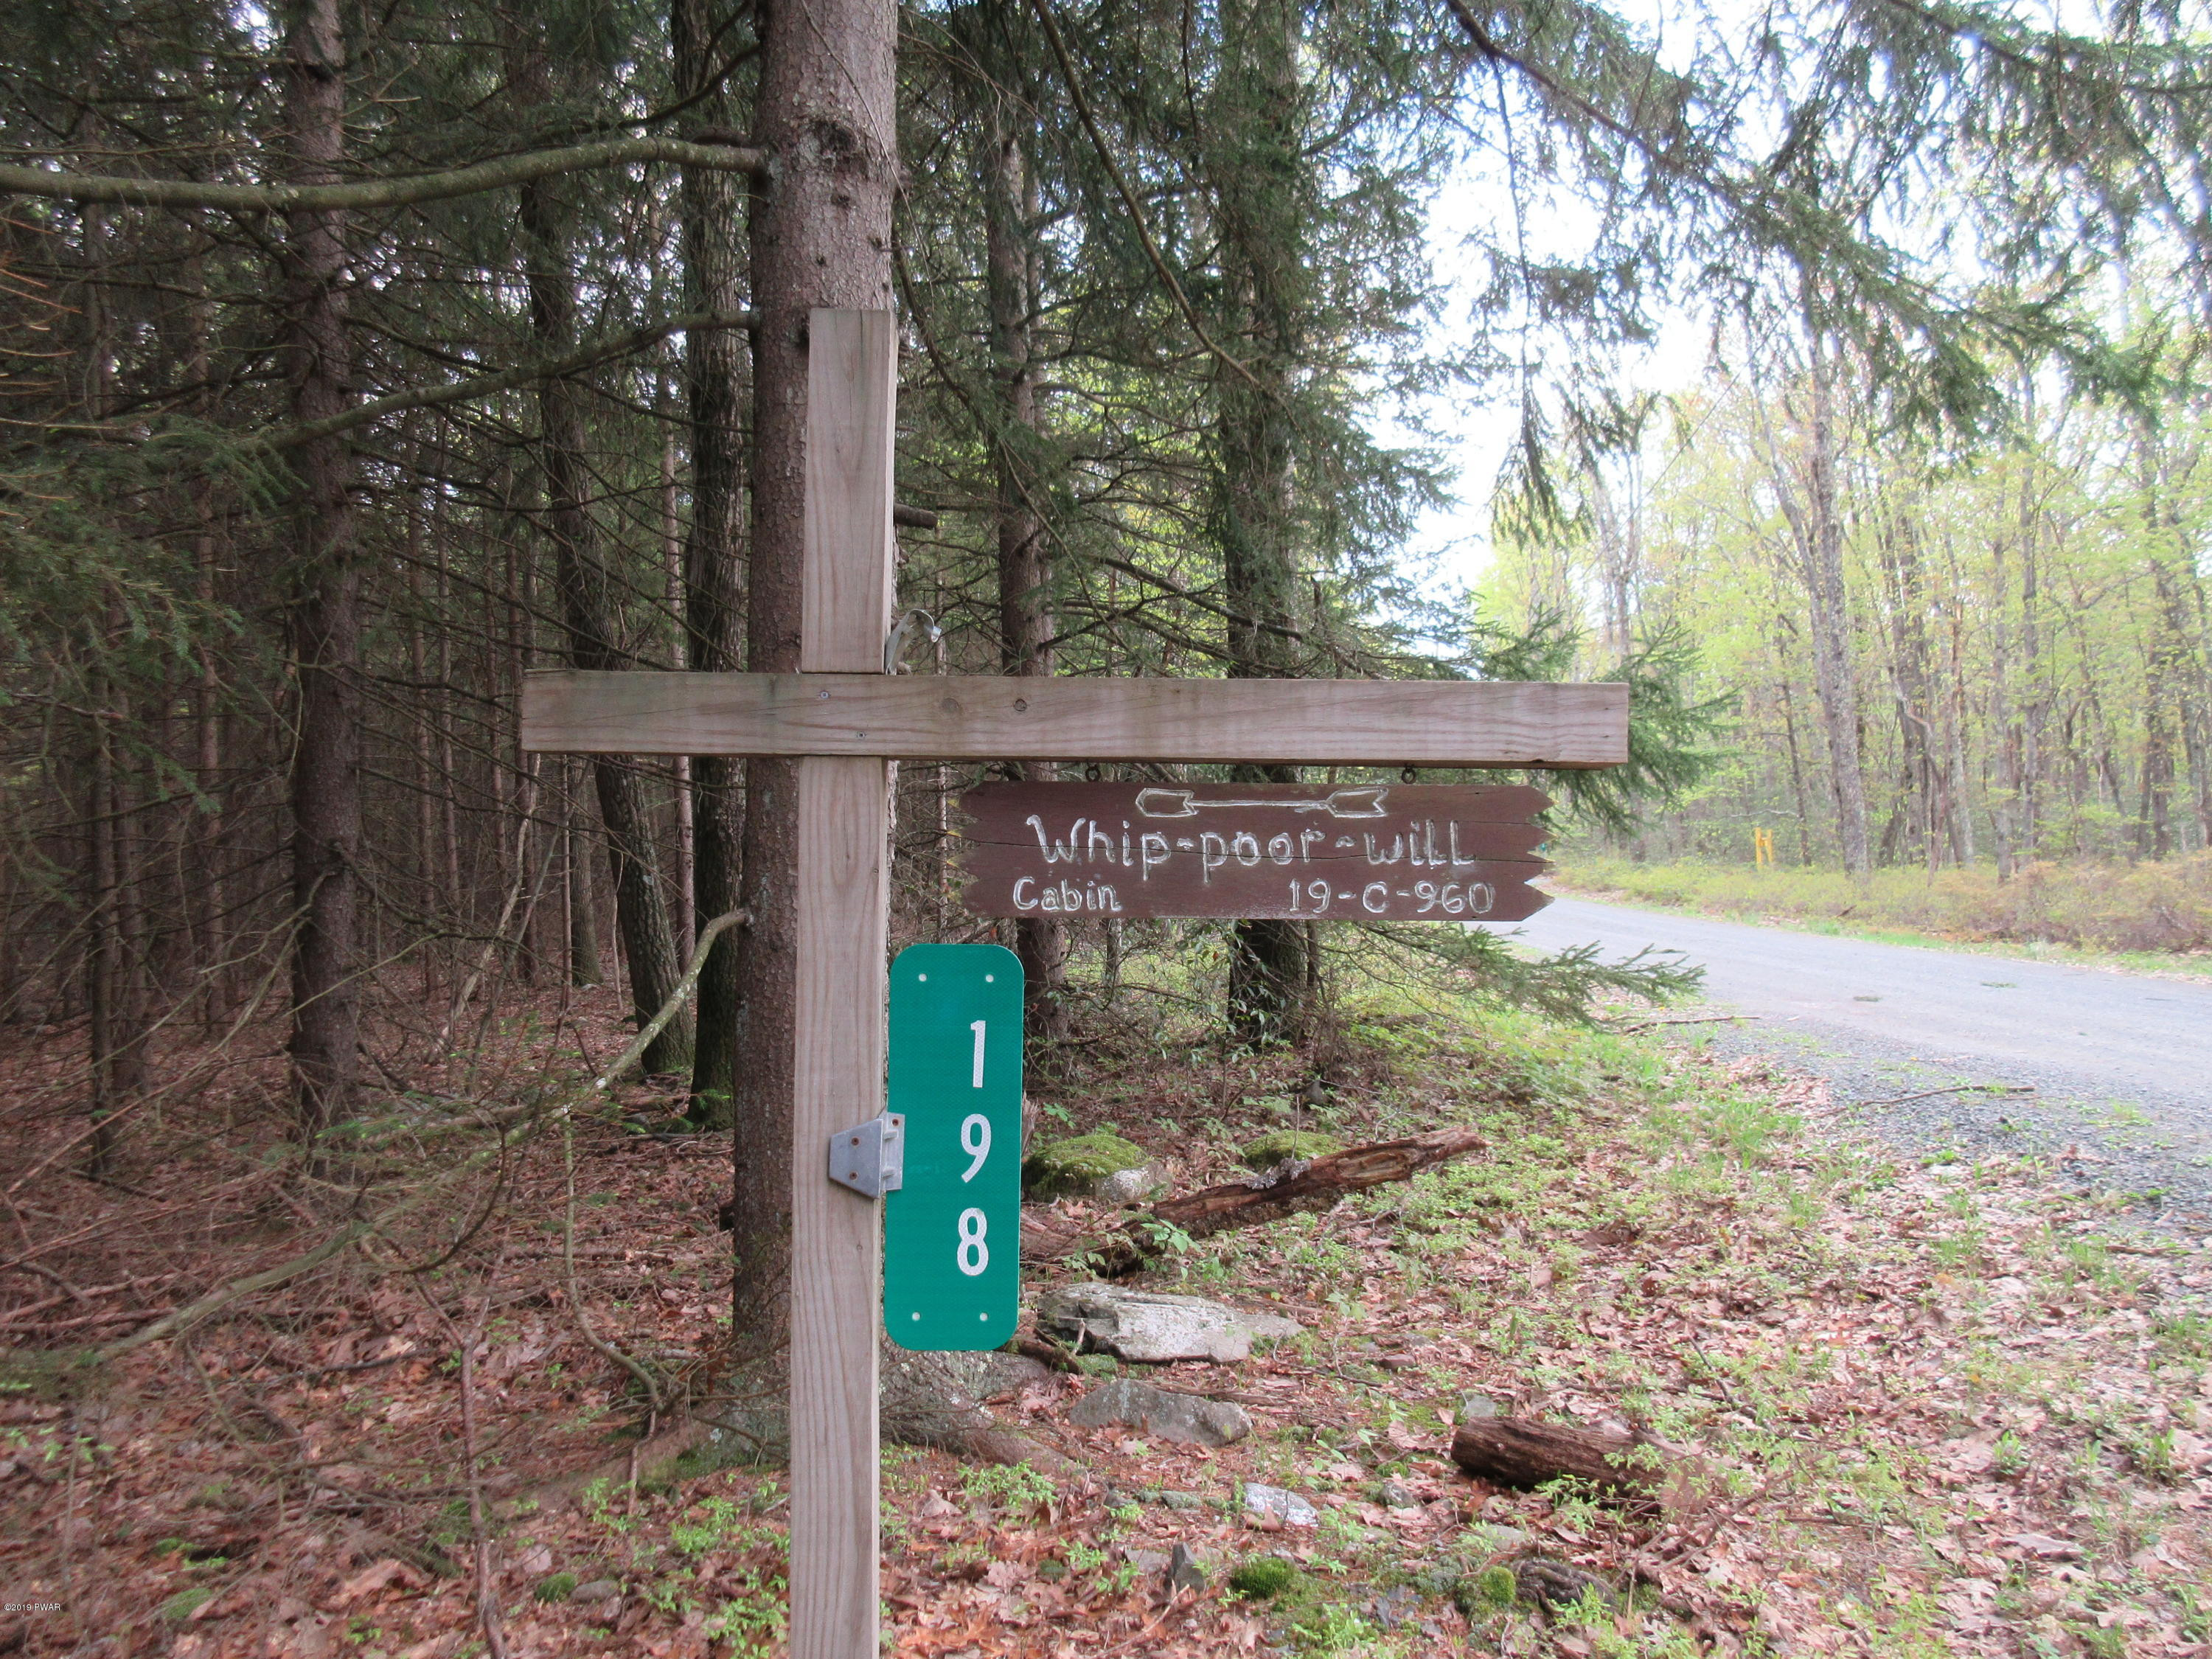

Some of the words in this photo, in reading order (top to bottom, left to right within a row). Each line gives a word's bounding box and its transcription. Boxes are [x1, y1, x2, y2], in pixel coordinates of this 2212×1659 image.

[1012, 875, 1123, 912] Cabin
[1288, 877, 1495, 914] 19-C-960
[957, 1020, 992, 1276] 198
